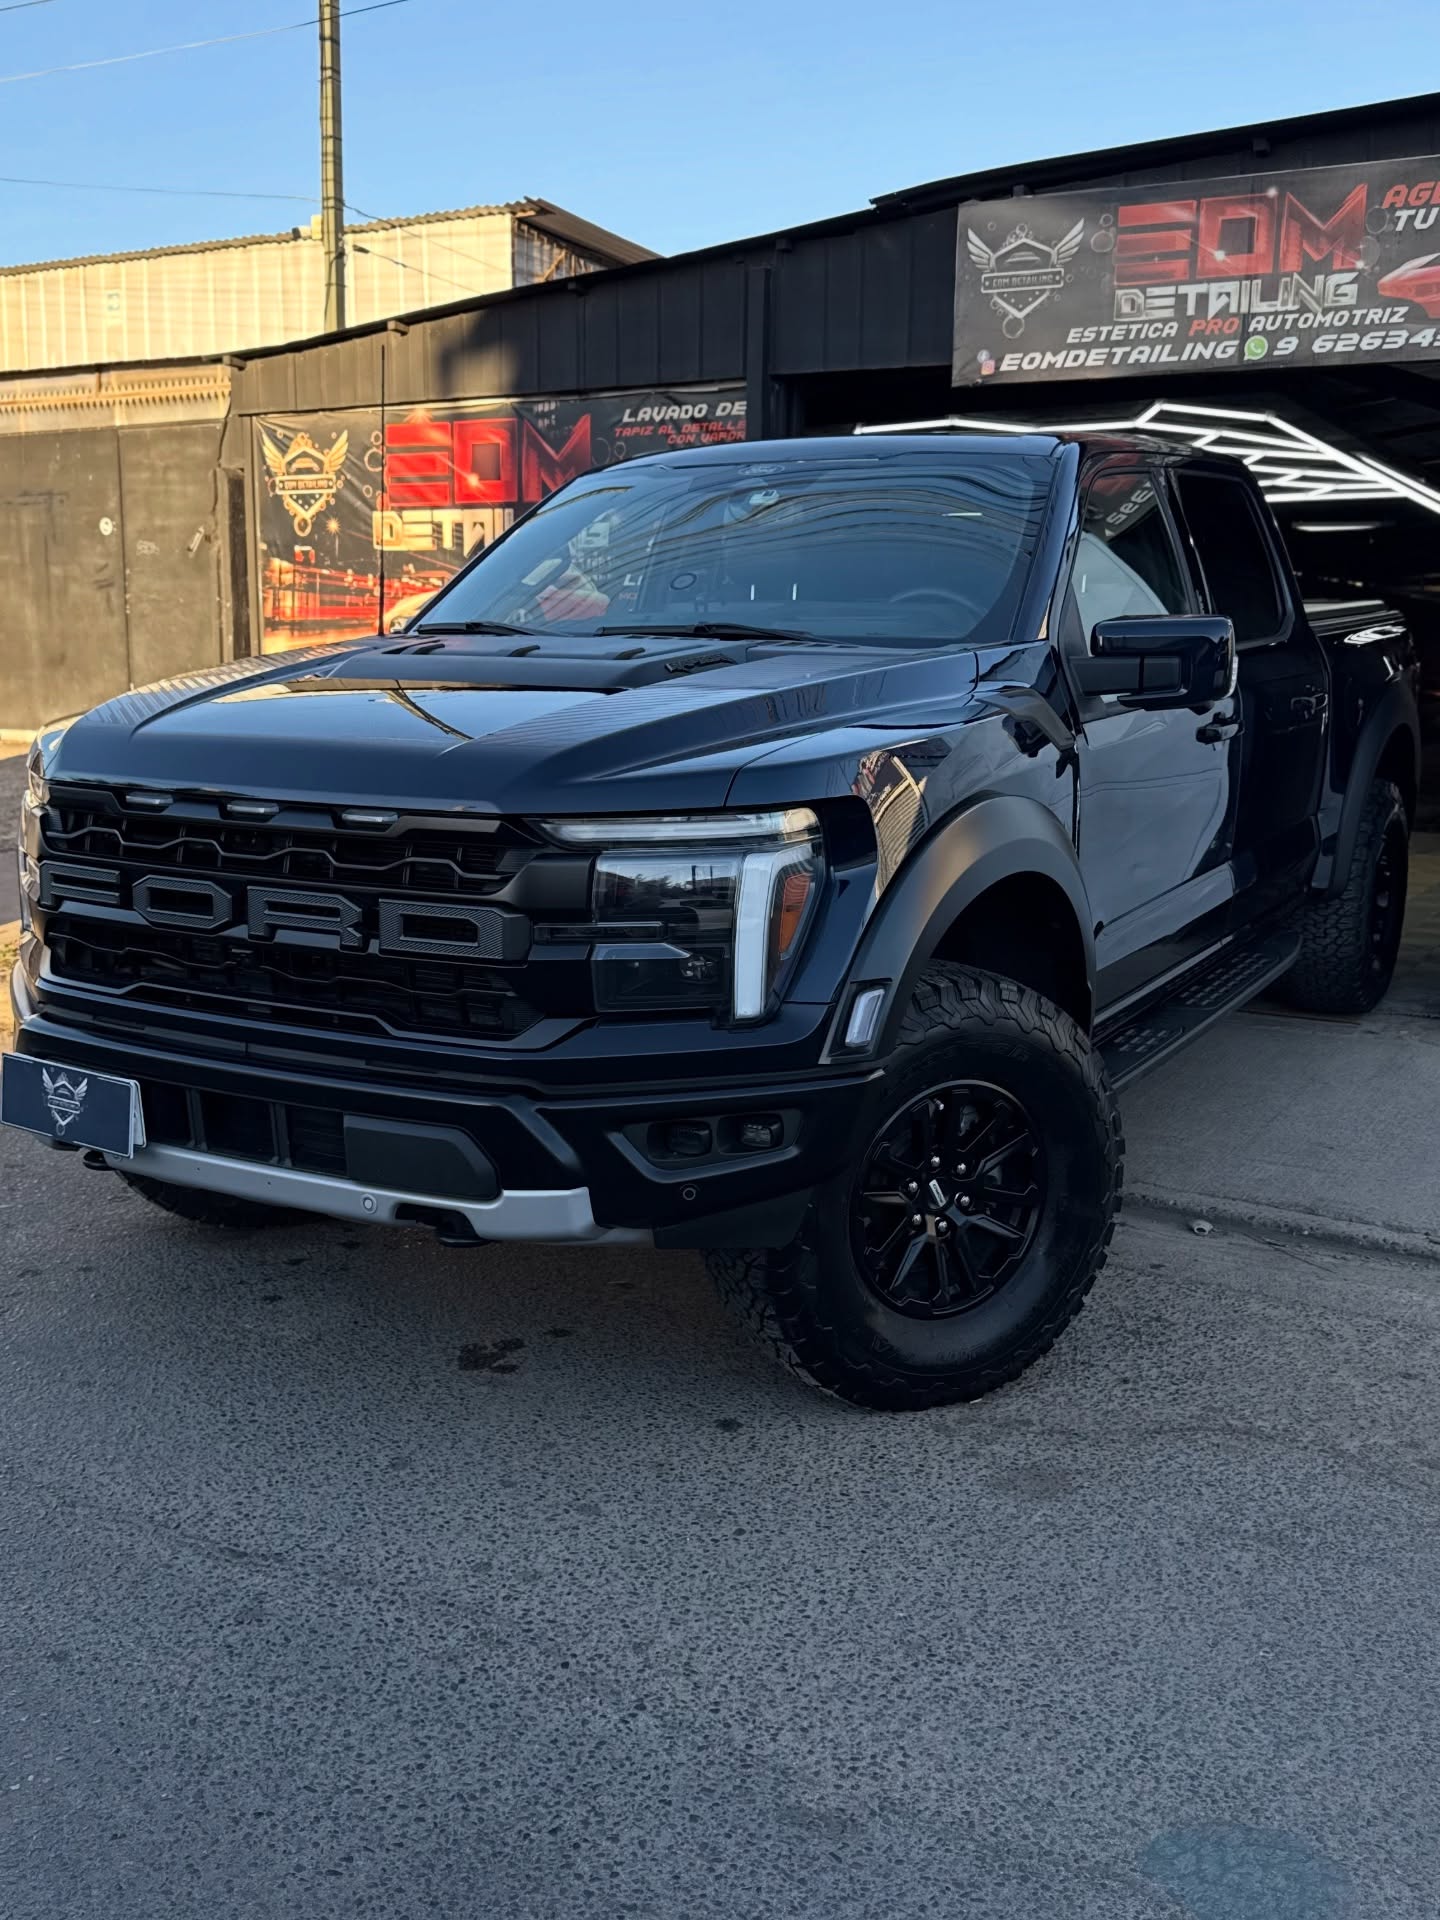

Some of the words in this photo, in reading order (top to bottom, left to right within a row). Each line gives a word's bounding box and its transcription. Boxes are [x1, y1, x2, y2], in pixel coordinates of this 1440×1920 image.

[1113, 183, 1368, 286] EOM
[1113, 271, 1359, 321] DETAILING
[1066, 321, 1179, 344] ESTETICA
[1188, 317, 1240, 337] PRO
[1248, 306, 1409, 332] AUTOMOTRIZ
[999, 340, 1240, 371] EOMDETAILING
[1273, 336, 1299, 356] 9
[614, 426, 654, 437] TAPIZ
[658, 424, 676, 435] AL
[682, 419, 747, 433] DETALLE
[622, 403, 708, 422] LAVADO
[715, 401, 747, 417] DE
[667, 433, 695, 445] CON
[386, 413, 592, 507] EOM
[38, 859, 506, 959] FORD
